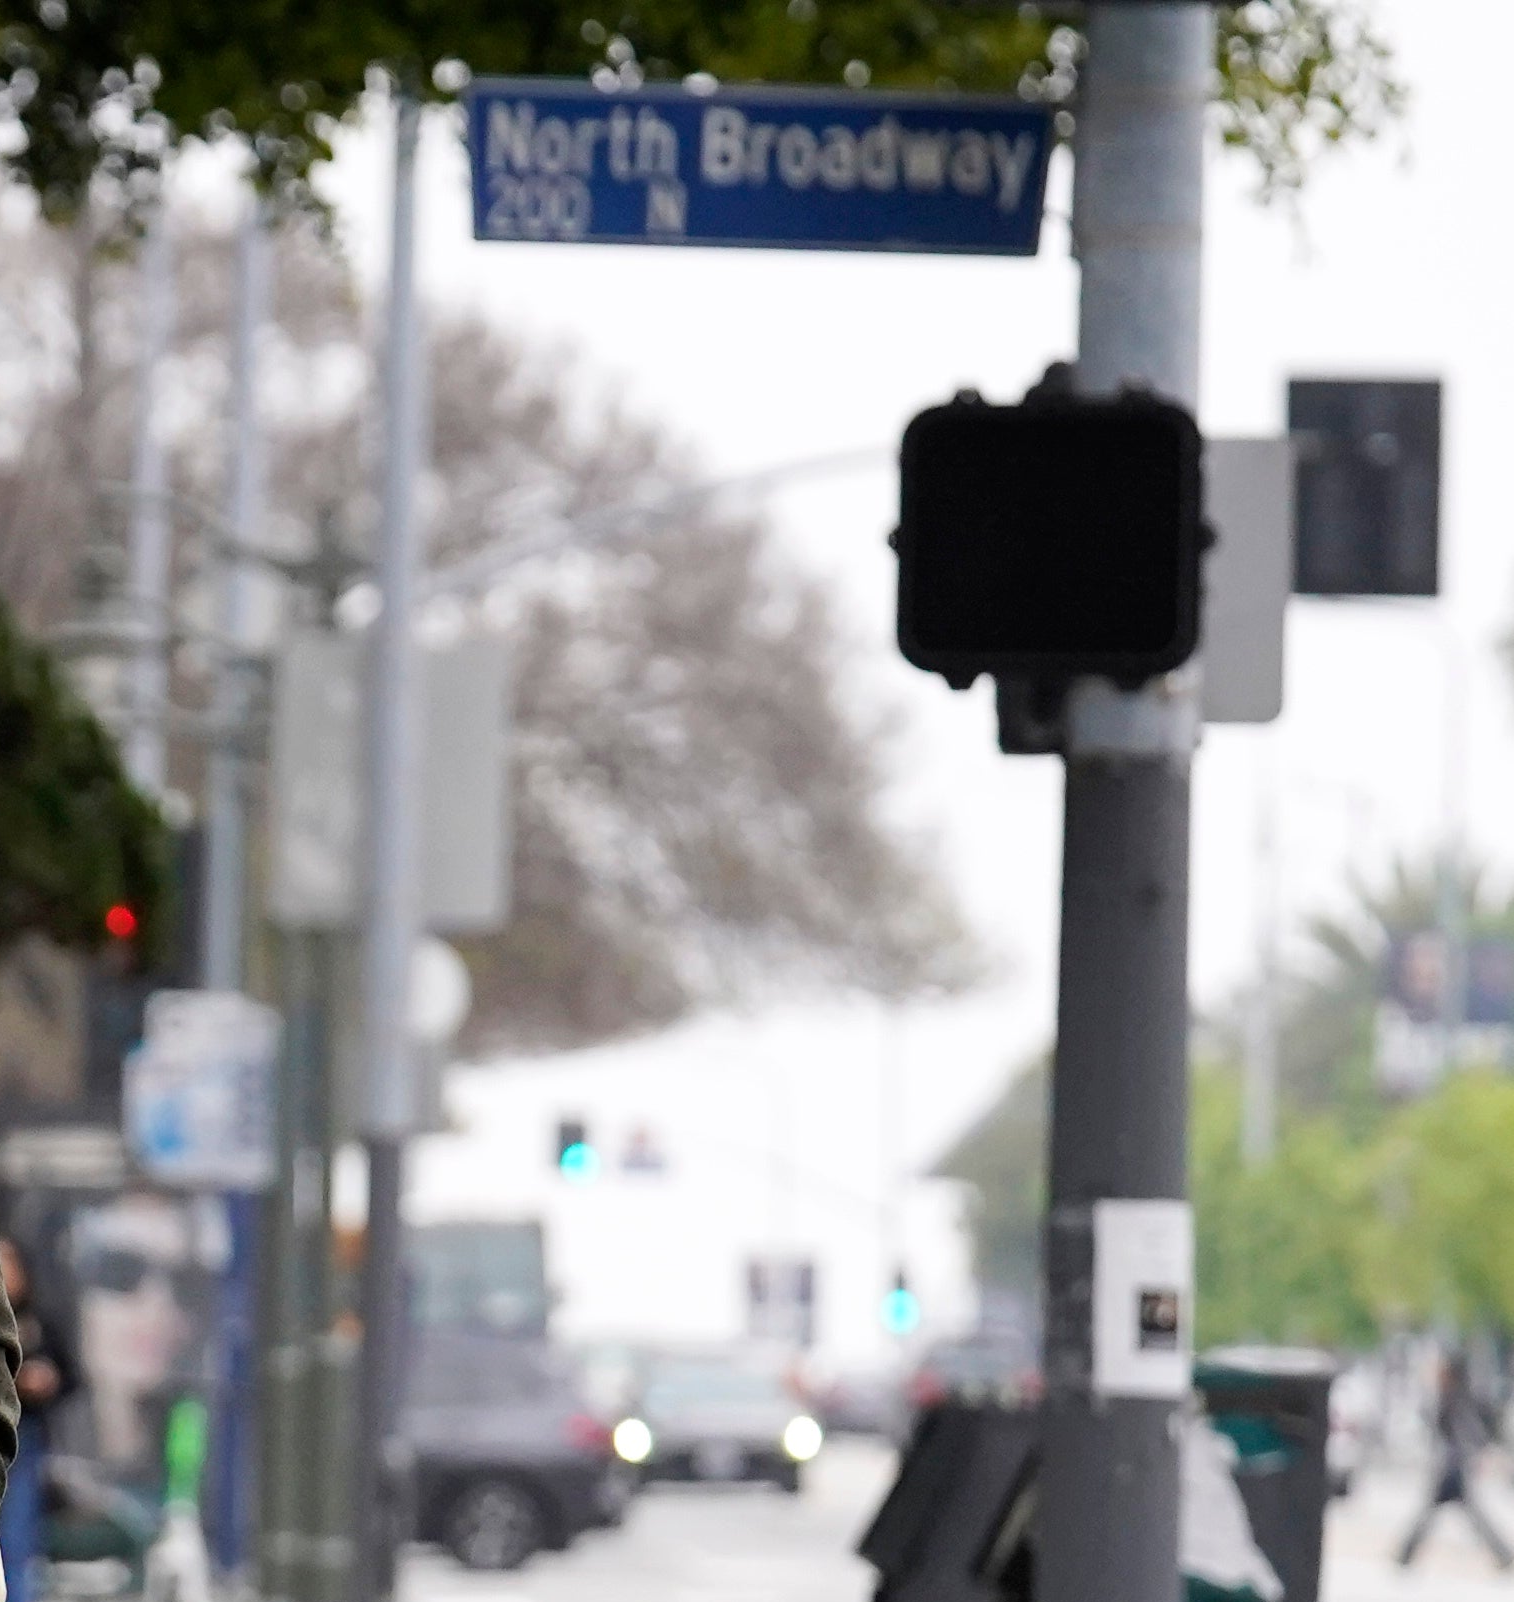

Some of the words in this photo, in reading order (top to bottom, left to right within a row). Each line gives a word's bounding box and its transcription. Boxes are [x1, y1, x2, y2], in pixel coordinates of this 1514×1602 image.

[485, 101, 680, 182] North
[701, 106, 1034, 213] Broadway
[485, 173, 591, 238] 200
[646, 181, 687, 236] N
